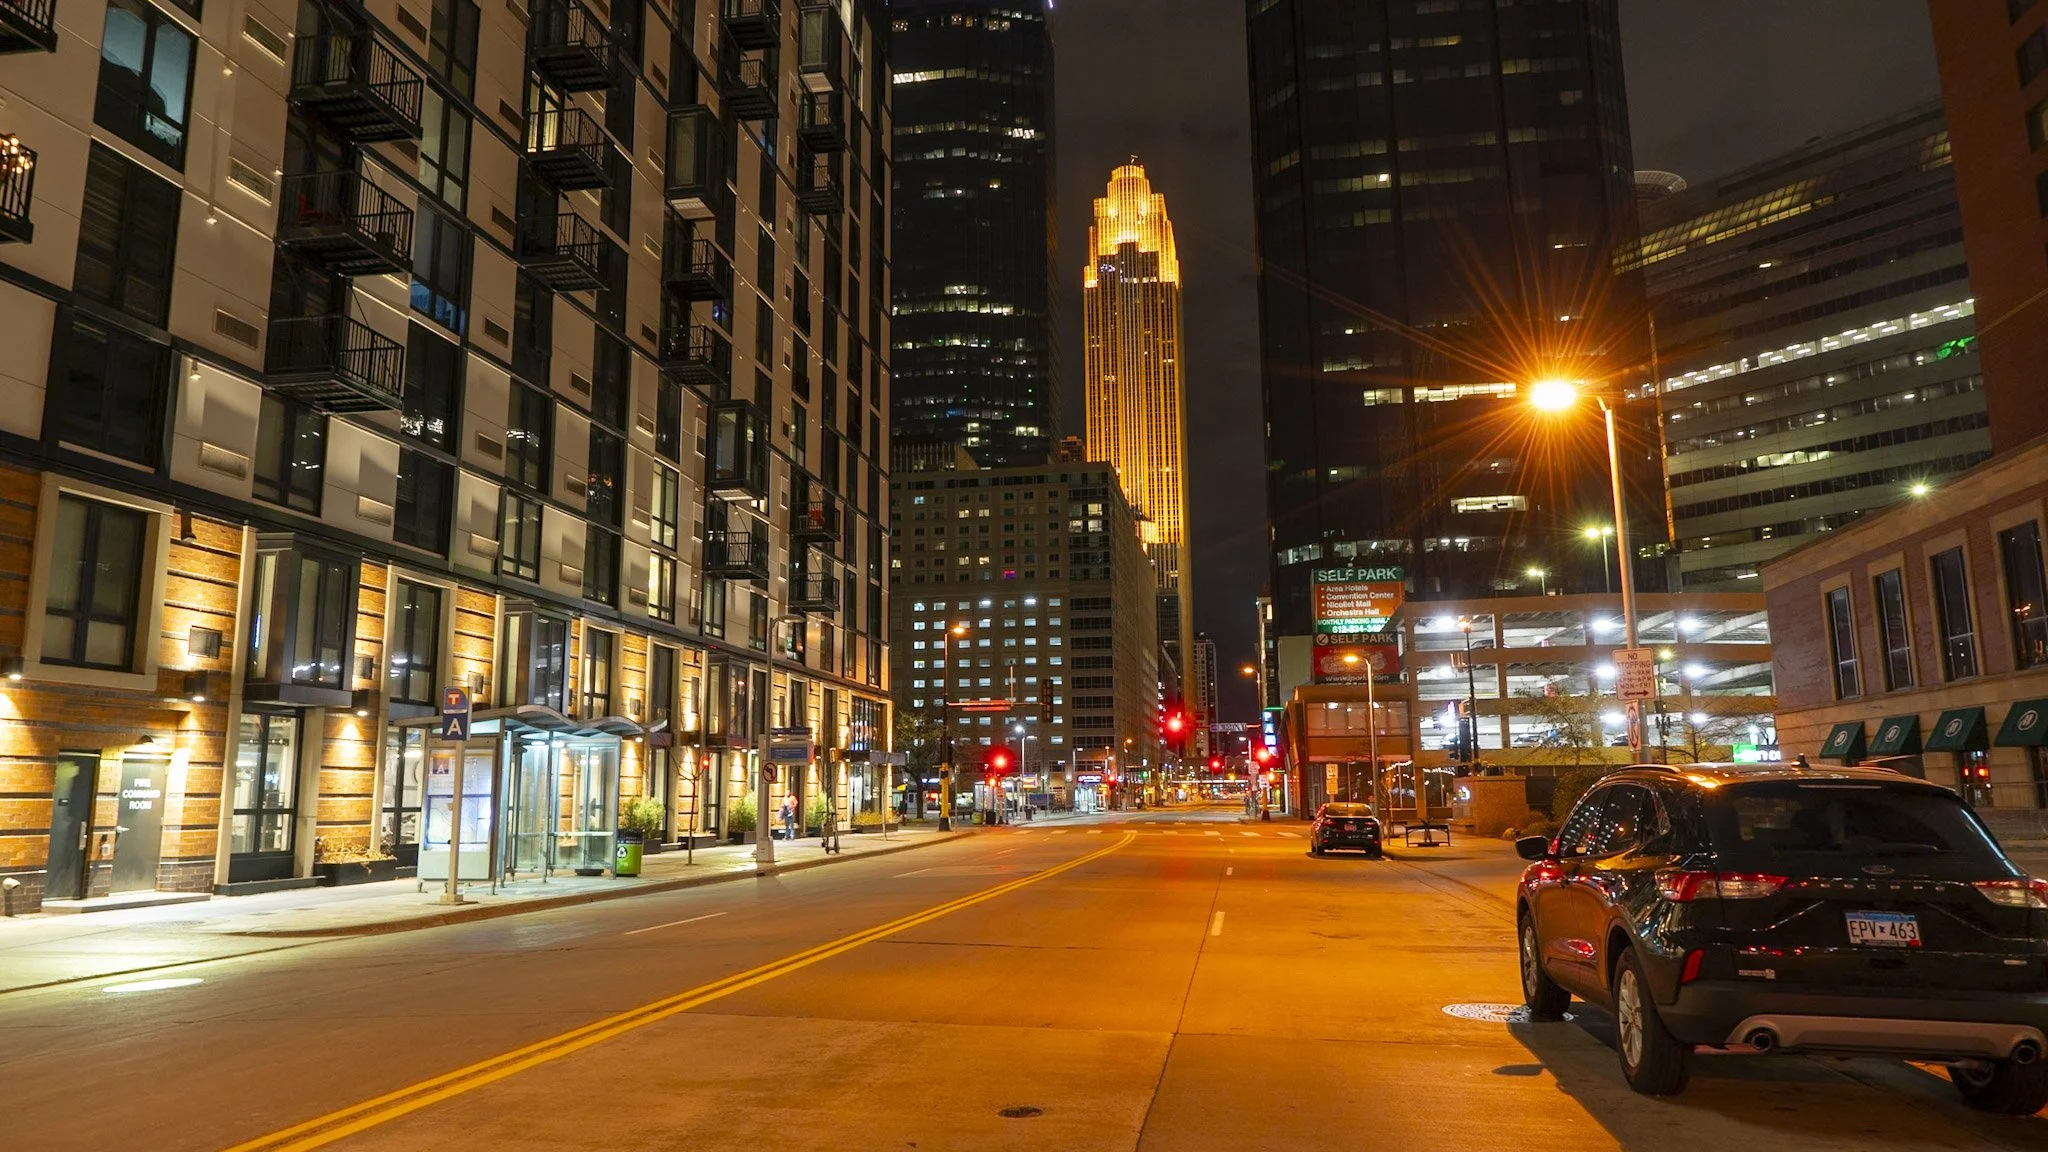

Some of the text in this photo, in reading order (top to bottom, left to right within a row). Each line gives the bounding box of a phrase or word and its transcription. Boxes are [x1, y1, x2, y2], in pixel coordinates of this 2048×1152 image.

[1318, 567, 1397, 581] SELF PARK
[1345, 584, 1368, 592] Hotels
[1326, 591, 1394, 600] Convention Center
[1326, 600, 1355, 608] Nicollet
[1326, 607, 1380, 616] Orchestra Hall
[1330, 633, 1393, 644] SELF PARK
[446, 717, 462, 736] A
[129, 800, 153, 810] ROOM
[1849, 920, 1917, 939] EPV 463
